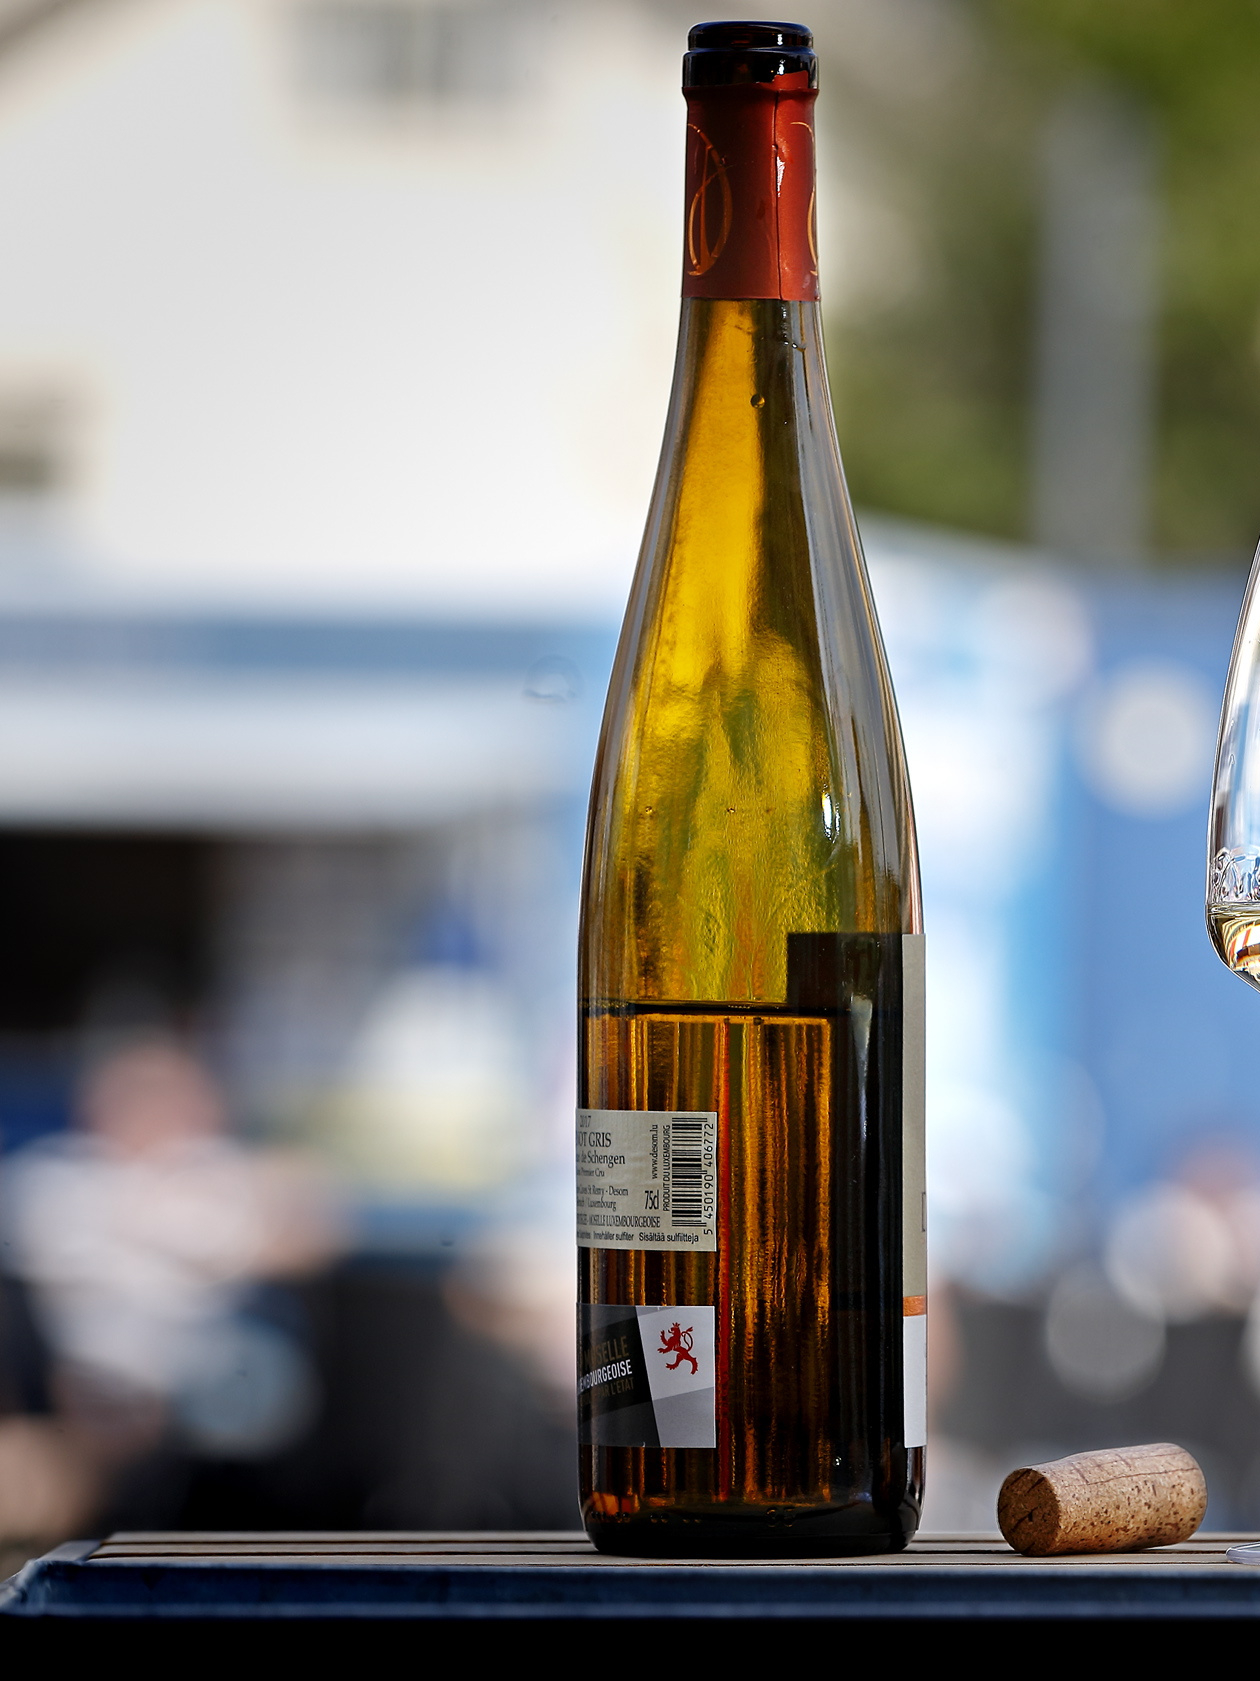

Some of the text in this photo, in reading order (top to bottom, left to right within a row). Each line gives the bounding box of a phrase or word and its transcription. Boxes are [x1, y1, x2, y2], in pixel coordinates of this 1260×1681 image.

[588, 1131, 612, 1148] GRIS
[703, 1123, 714, 1168] 406772
[587, 1150, 626, 1169] Schengen
[649, 1124, 659, 1180] www.desom.lu
[594, 1167, 605, 1177] Cru
[663, 1124, 671, 1212] PRODUIT DU LUXEMBOURG
[608, 1185, 629, 1197] Desom
[644, 1189, 660, 1210] 75cl
[703, 1174, 714, 1219] 450190
[587, 1195, 617, 1212] Luxembourg
[606, 1215, 661, 1228] LUXEMBOURGEOISE
[615, 1231, 634, 1241] sulfiter
[638, 1231, 665, 1243] Sisältää
[666, 1232, 699, 1245] sulfiitteja
